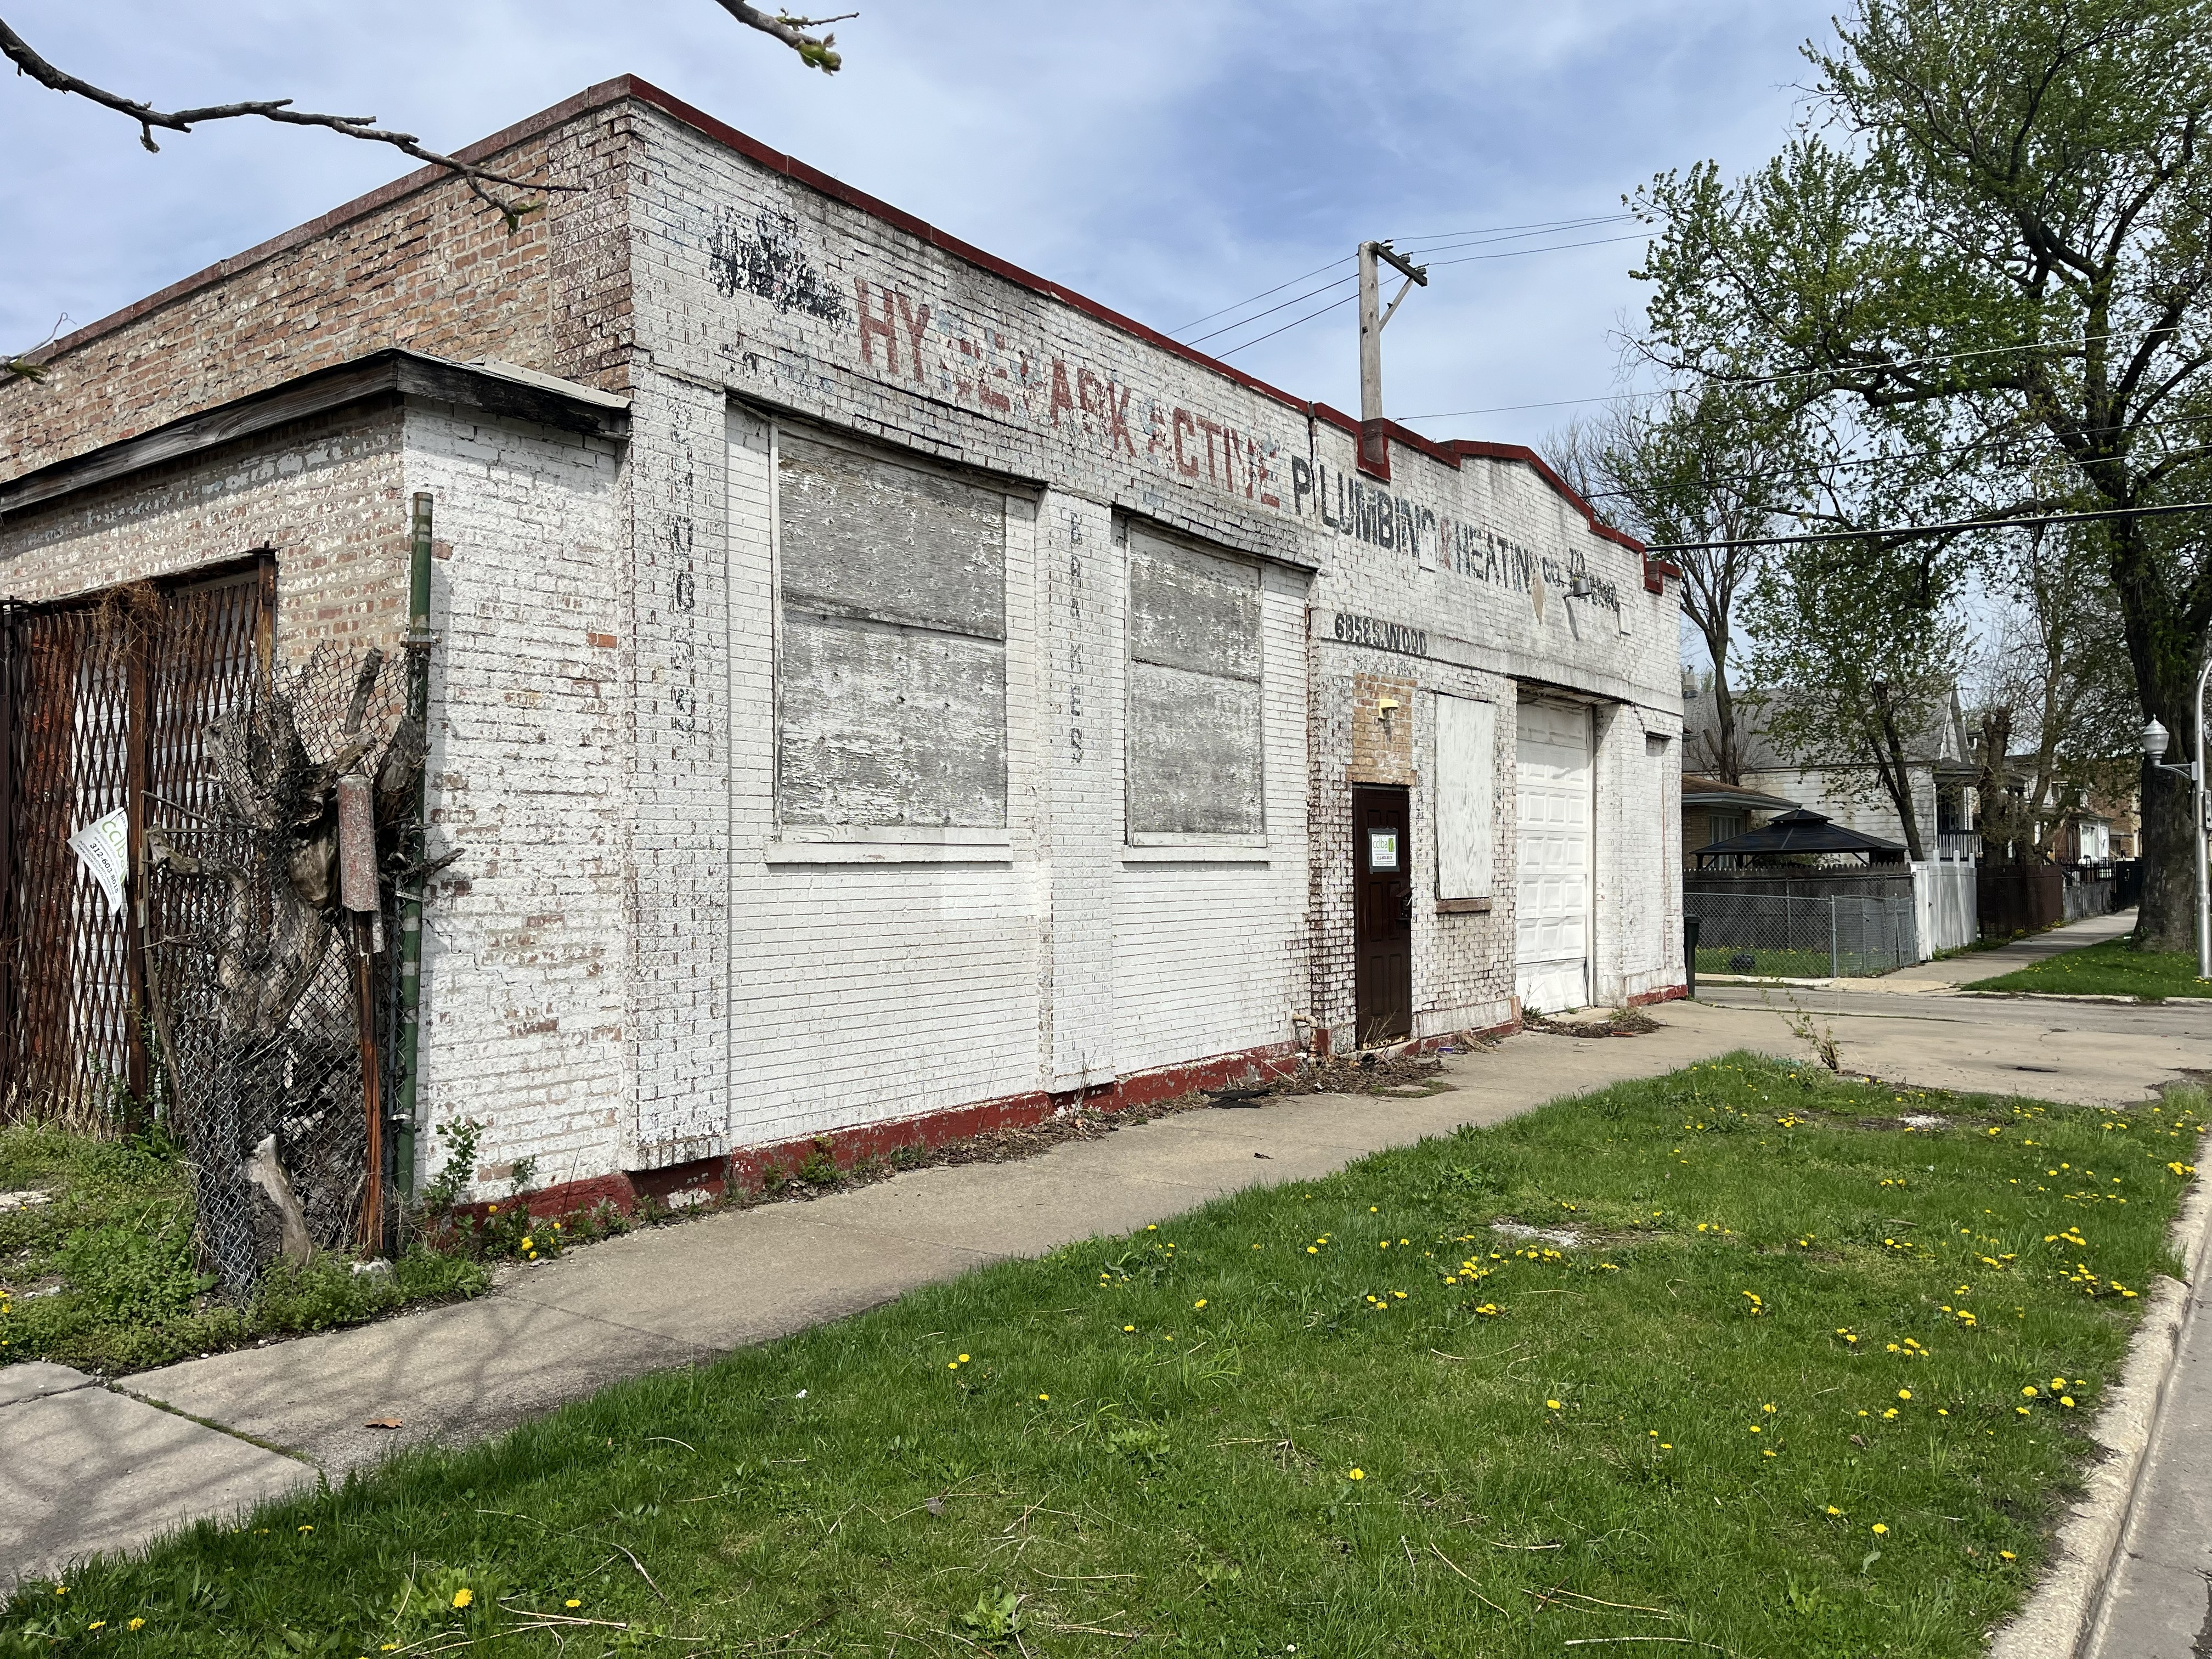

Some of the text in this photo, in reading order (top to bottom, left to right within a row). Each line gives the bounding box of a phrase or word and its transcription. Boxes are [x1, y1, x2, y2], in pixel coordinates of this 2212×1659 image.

[854, 276, 1010, 413] HYE
[1019, 350, 1137, 458] ARK
[89, 843, 119, 894] 312-603-8015
[101, 820, 126, 869] cclba
